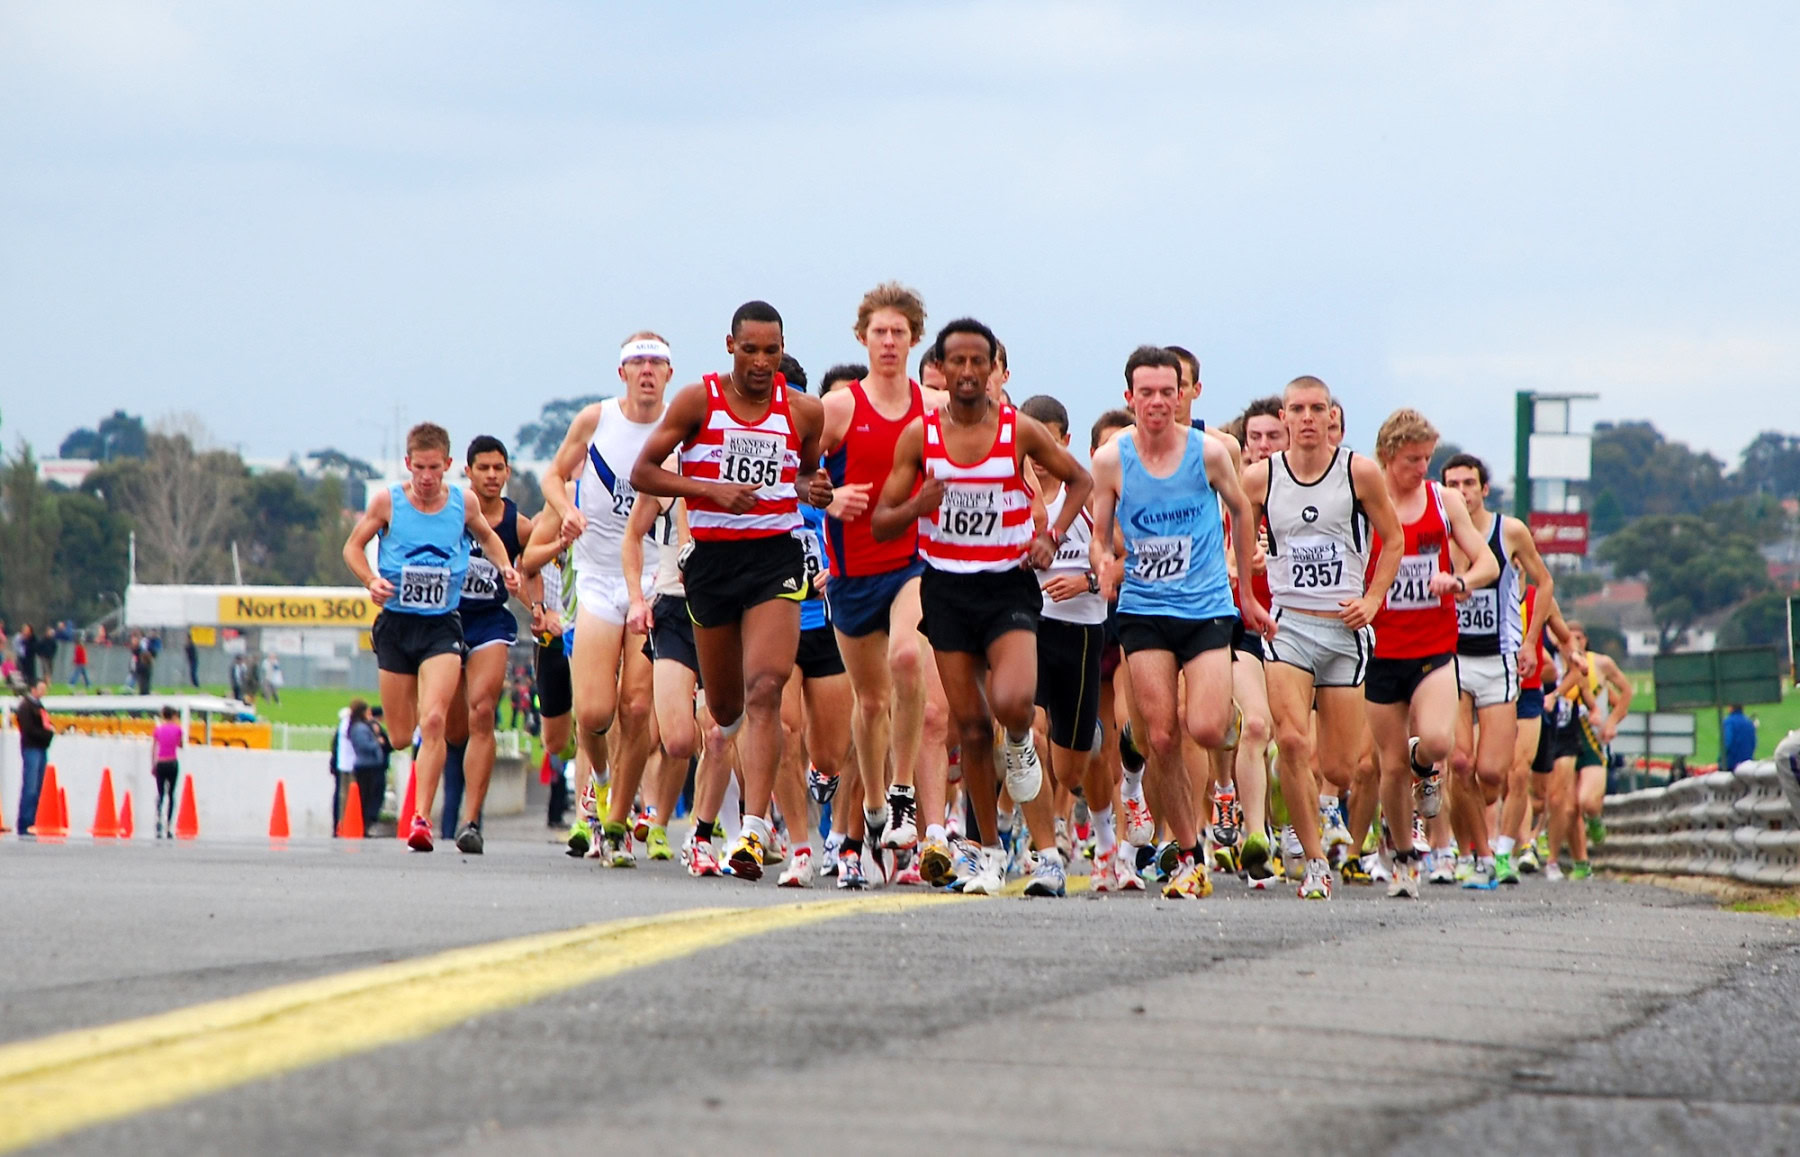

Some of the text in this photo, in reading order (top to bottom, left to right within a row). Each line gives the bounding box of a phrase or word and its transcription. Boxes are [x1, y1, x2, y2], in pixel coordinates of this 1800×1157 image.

[730, 436, 771, 449] RUNNERS
[730, 444, 762, 455] WORLD
[723, 455, 778, 487] 1635
[945, 497, 978, 509] WORLD
[943, 508, 998, 536] 1627
[1292, 545, 1330, 555] RUNNERS
[1293, 553, 1323, 562] WORLD
[1292, 560, 1343, 588] 2357
[402, 583, 444, 604] 2310
[236, 598, 366, 619] Norton 360
